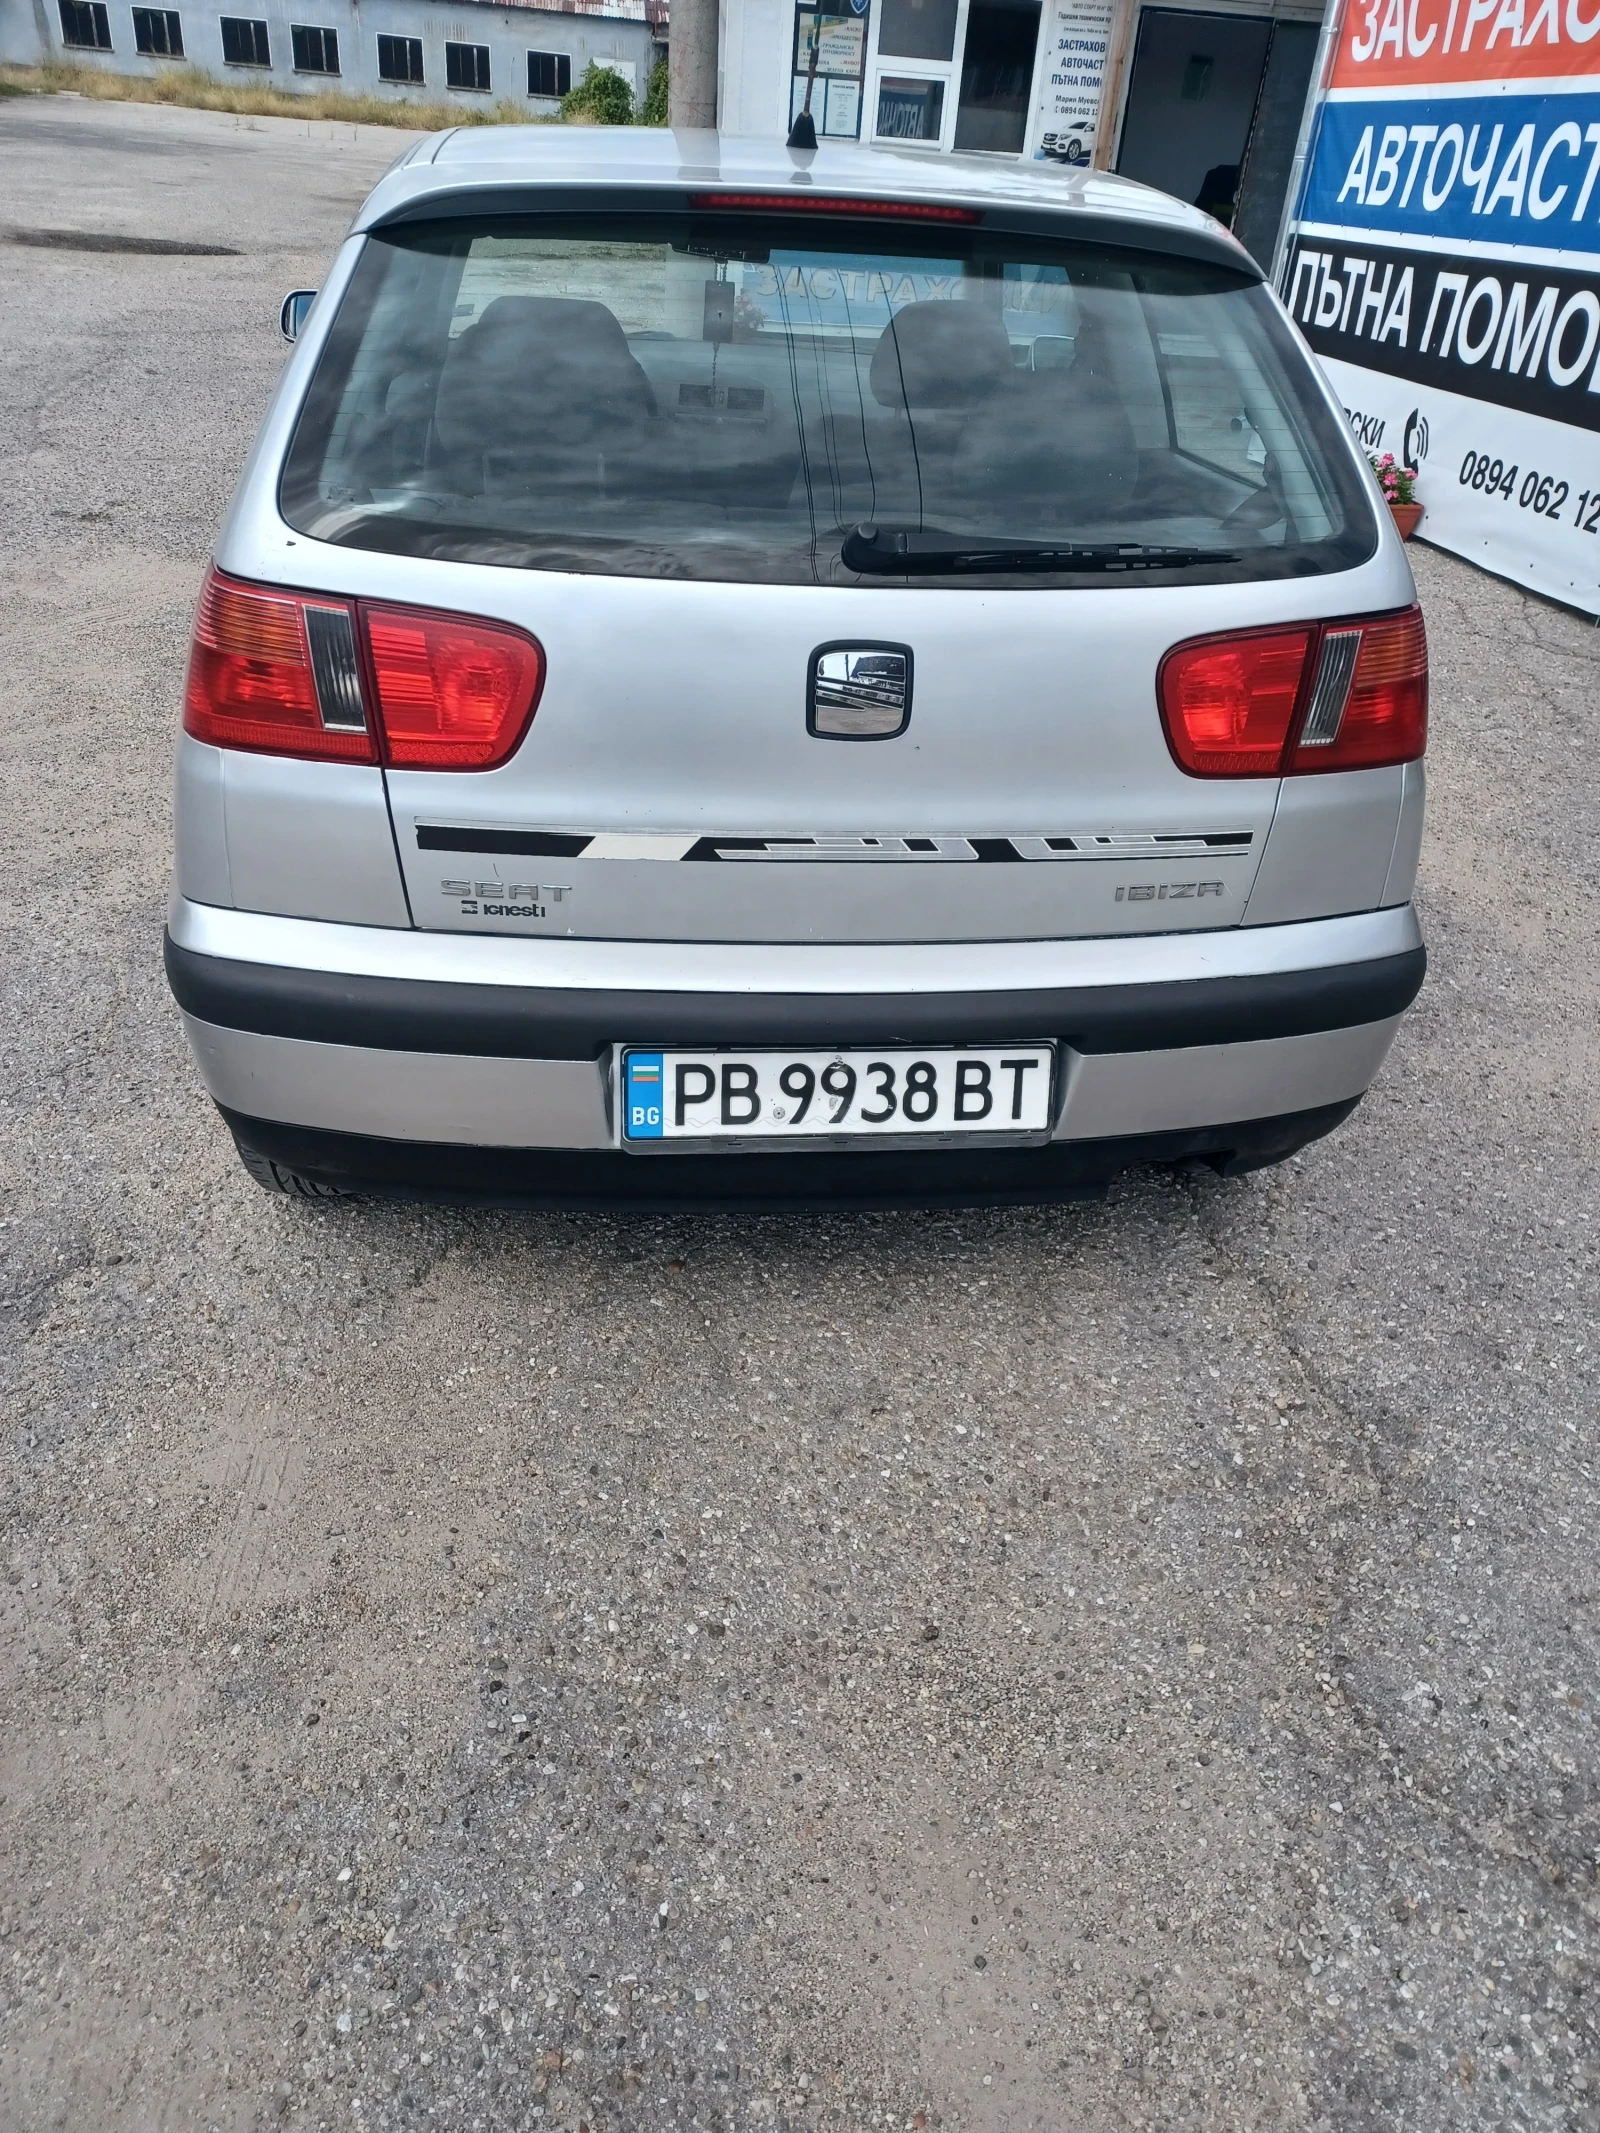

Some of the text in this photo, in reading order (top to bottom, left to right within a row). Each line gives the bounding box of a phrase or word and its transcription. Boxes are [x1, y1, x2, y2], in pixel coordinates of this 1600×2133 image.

[1058, 39, 1106, 53] ЗАСТРАХОВ
[1060, 57, 1105, 71] АВТОЧАСТ
[1051, 74, 1079, 87] ПЪТНА
[1337, 121, 1600, 222] АВТОЧАСТ
[1288, 250, 1600, 394] ПЪТНА ПОМО
[1459, 450, 1600, 534] 0894 062 12
[441, 878, 572, 902] SEAT
[1114, 880, 1225, 901] IBIZA
[675, 1060, 1039, 1126] PB 9938 BT
[632, 1106, 660, 1126] BG
